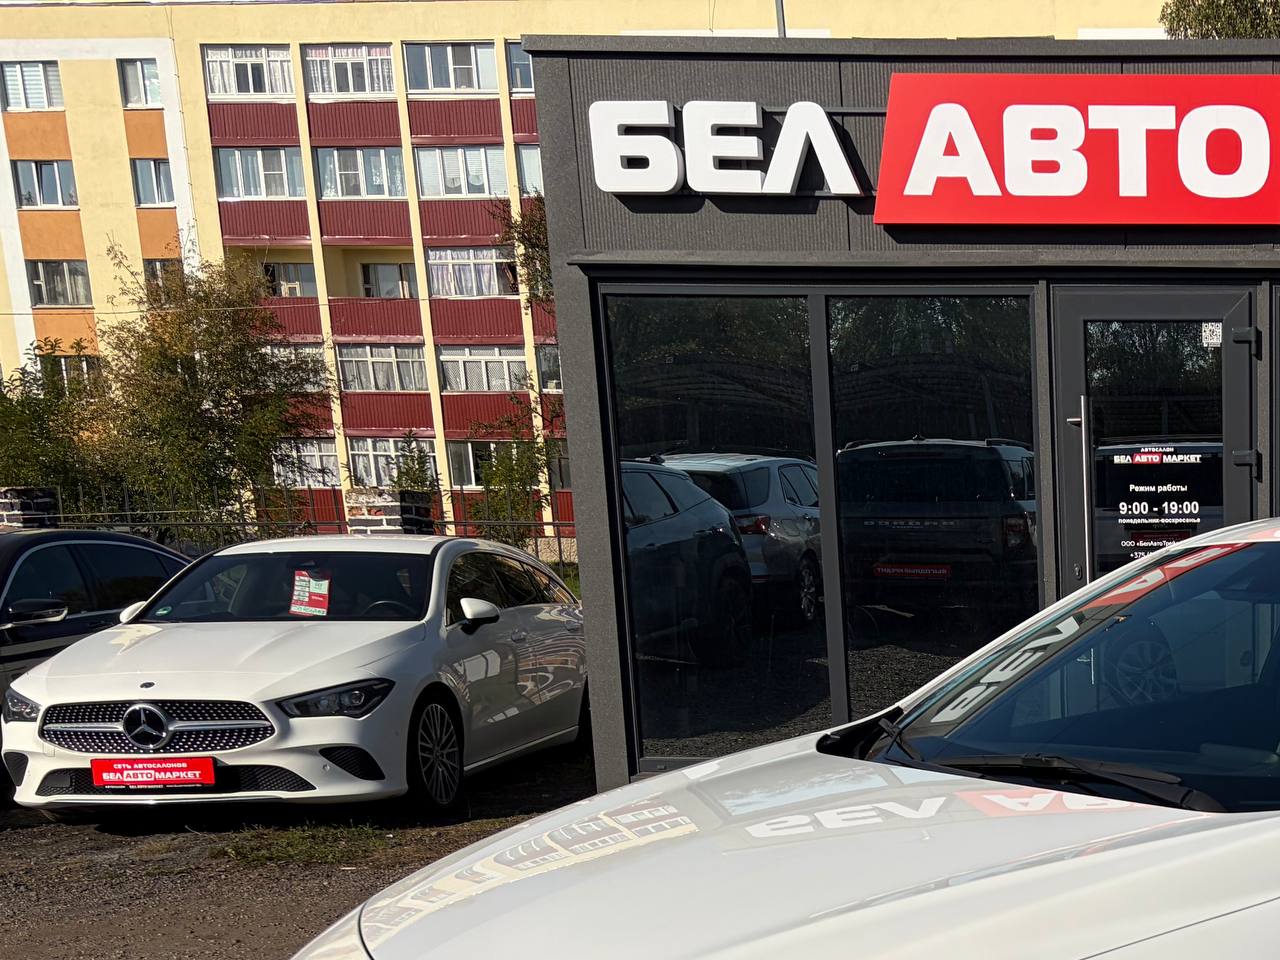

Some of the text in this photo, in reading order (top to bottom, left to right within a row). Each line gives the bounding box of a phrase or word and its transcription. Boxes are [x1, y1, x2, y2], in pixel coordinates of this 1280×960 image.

[588, 100, 861, 195] БЕЛ
[903, 102, 1271, 199] АВТО
[1113, 454, 1202, 463] БЕЛ АВТО МАРКЕТ
[1129, 483, 1188, 493] Режим работы
[1118, 501, 1149, 515] 9:00
[1161, 501, 1200, 514] 19:00
[102, 771, 201, 780] БЕЛ АВТО МАРКЕТ
